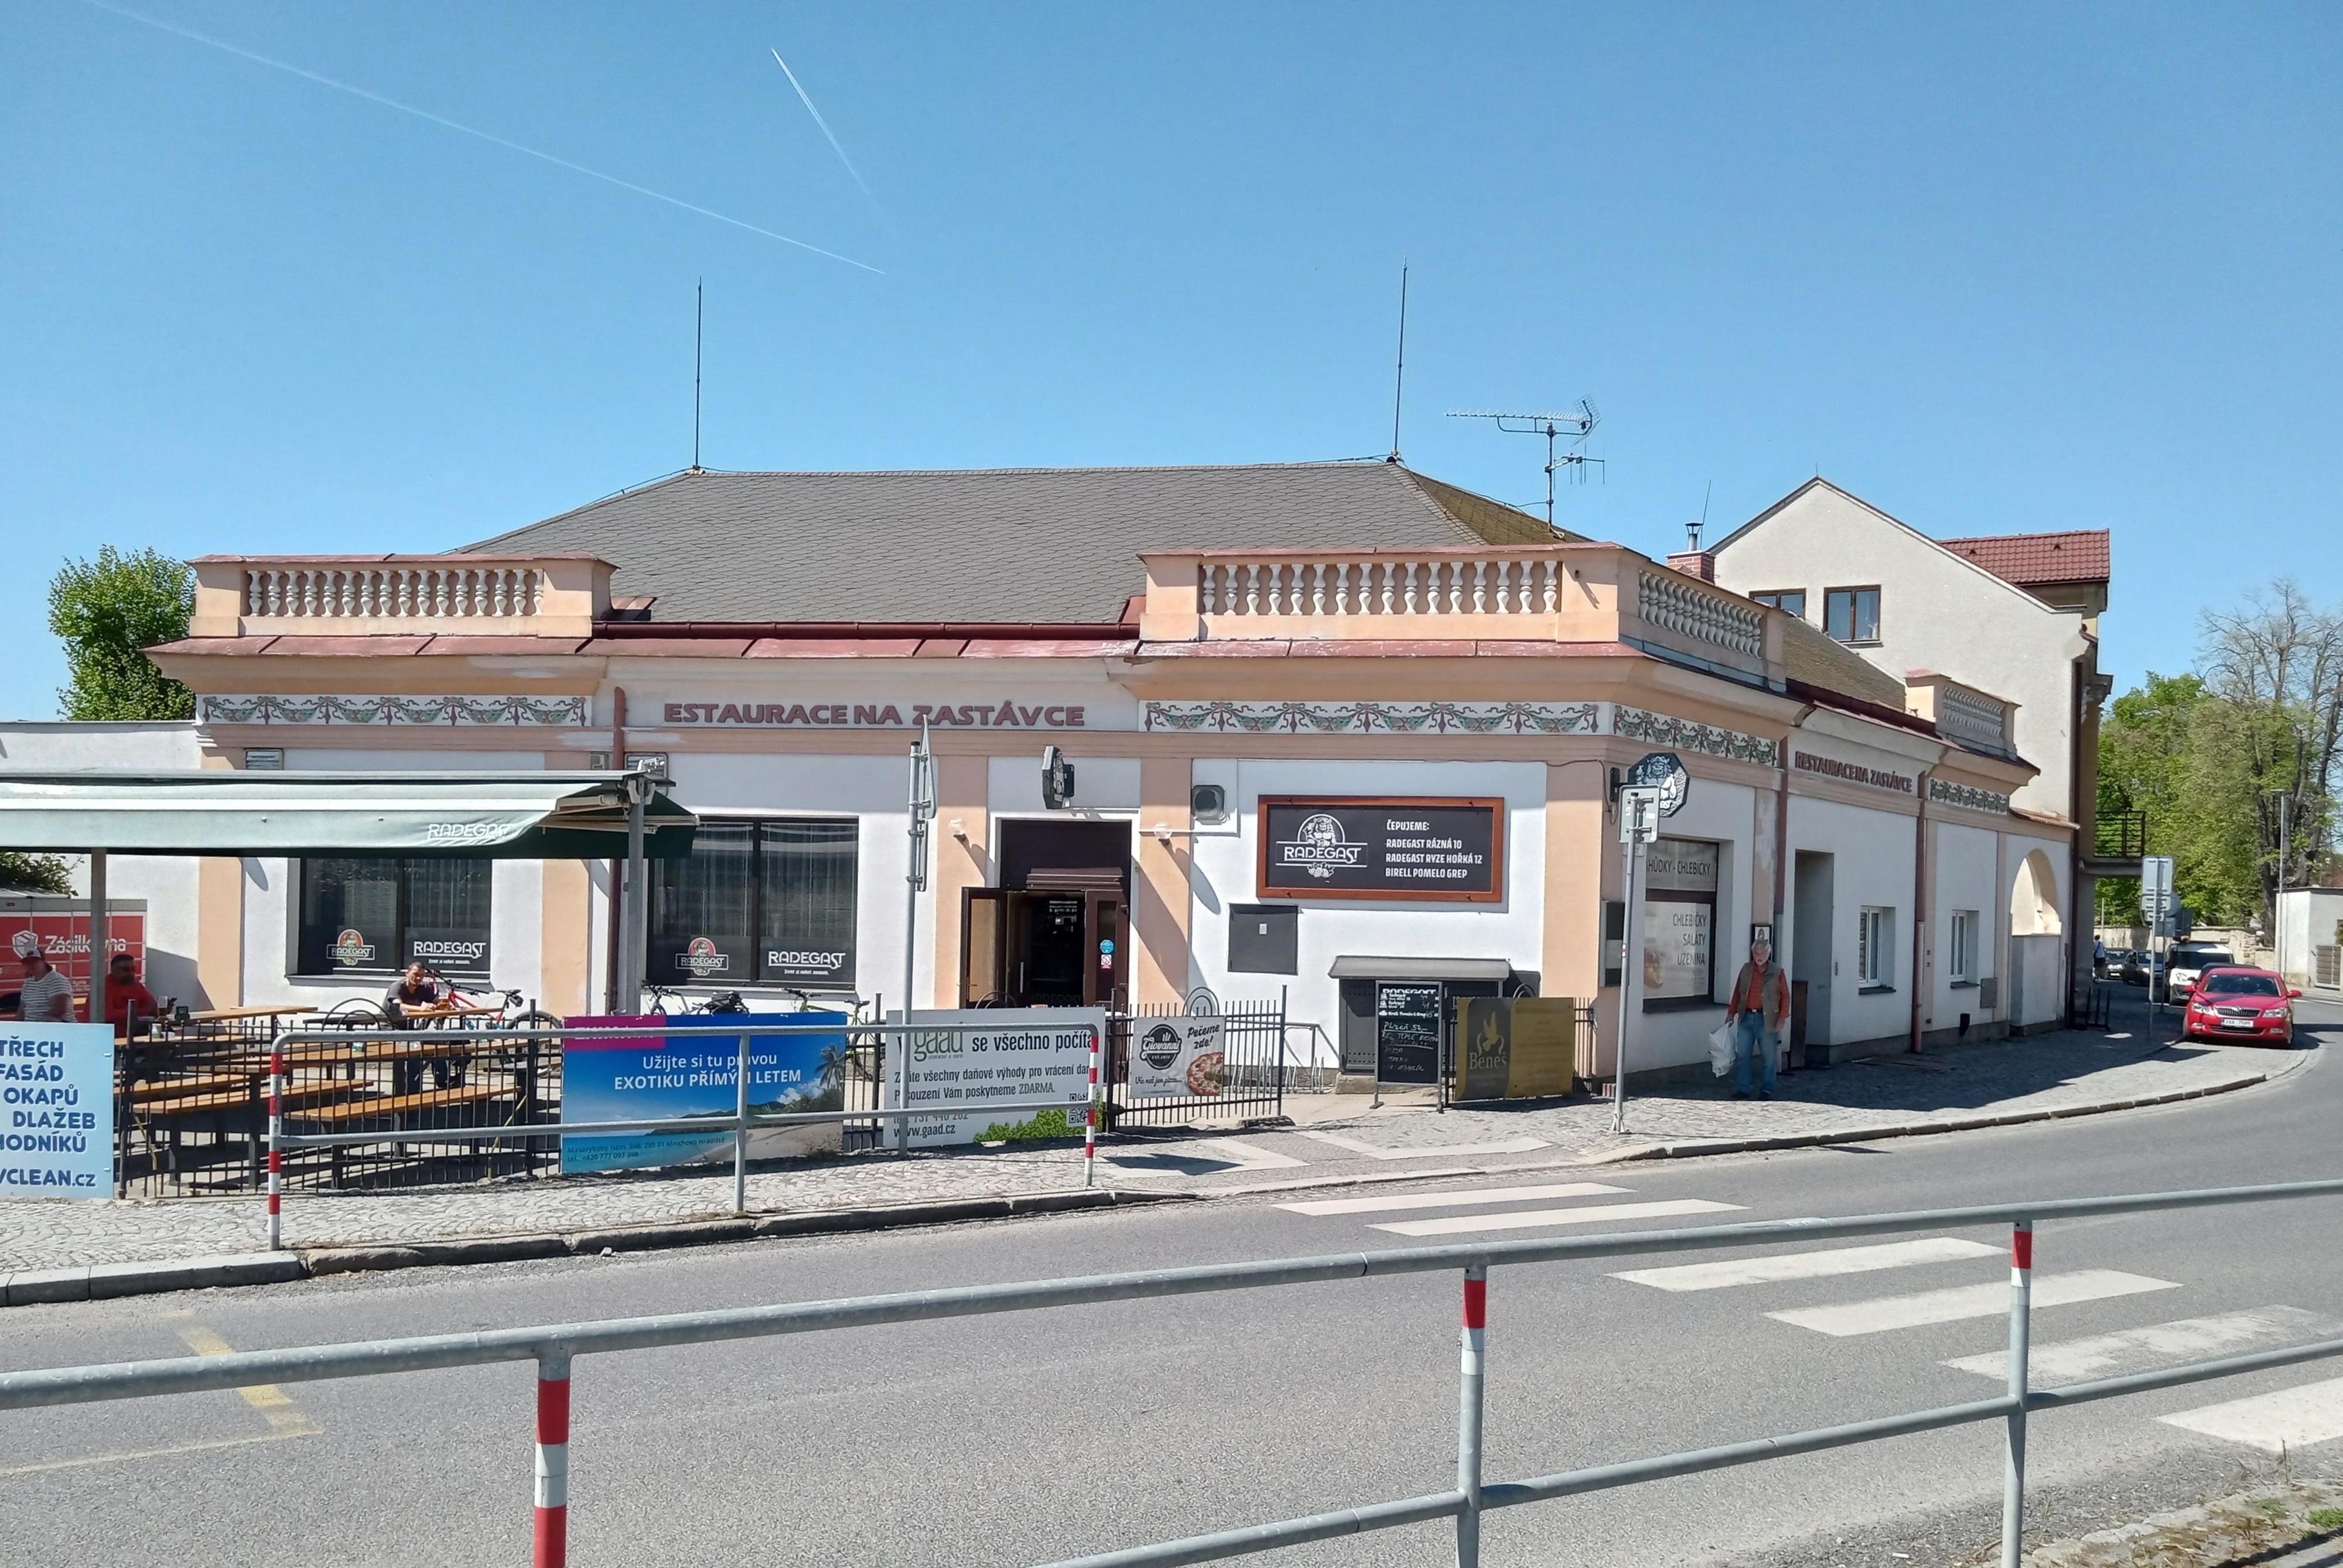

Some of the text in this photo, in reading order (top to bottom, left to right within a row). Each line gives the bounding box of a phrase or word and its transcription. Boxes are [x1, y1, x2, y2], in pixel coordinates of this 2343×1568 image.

[664, 700, 1085, 726] ESTAURACE NA ZASTÁVCE
[1795, 751, 1912, 792] RESTAURACE NA ZASTÁVCE
[1386, 819, 1430, 831] ČEPUJEME:
[1386, 837, 1462, 849] RADEGAST RÁZNÁ 10
[1284, 846, 1361, 864] RADEGAST
[1386, 852, 1483, 864] RADEGAST RYZE HOŘKÁ 12
[1385, 868, 1467, 878] BIRELL POMELO GREP
[45, 935, 127, 954] Zásilkna
[332, 947, 371, 958] RADEGAST
[414, 941, 486, 959] RADEGAST
[681, 957, 725, 967] RADEGAST
[769, 951, 846, 969] RADEGAST
[1187, 1024, 1220, 1038] Pečeme
[972, 1037, 988, 1052] se
[993, 1032, 1050, 1051] všechno
[1142, 1037, 1181, 1055] Giovanni
[1194, 1036, 1214, 1049] zde!
[643, 1055, 686, 1072] Užijte
[691, 1055, 703, 1068] si
[707, 1055, 722, 1067] tu
[1469, 1051, 1507, 1070] Beneš
[614, 1070, 801, 1090] EXOTIKU PŘÍMÝ LETEM
[895, 1071, 920, 1083] Záte
[924, 1070, 959, 1082] všechny
[963, 1067, 993, 1080] daňové
[996, 1067, 1026, 1081] výhody
[1029, 1068, 1042, 1078] pro
[1045, 1064, 1074, 1075] vrácení
[4, 1084, 78, 1105] OKAPŮ
[894, 1082, 1056, 1101] Psouzení Vám poskytneme ZDARMA.
[13, 1107, 96, 1129] DLAŽEB
